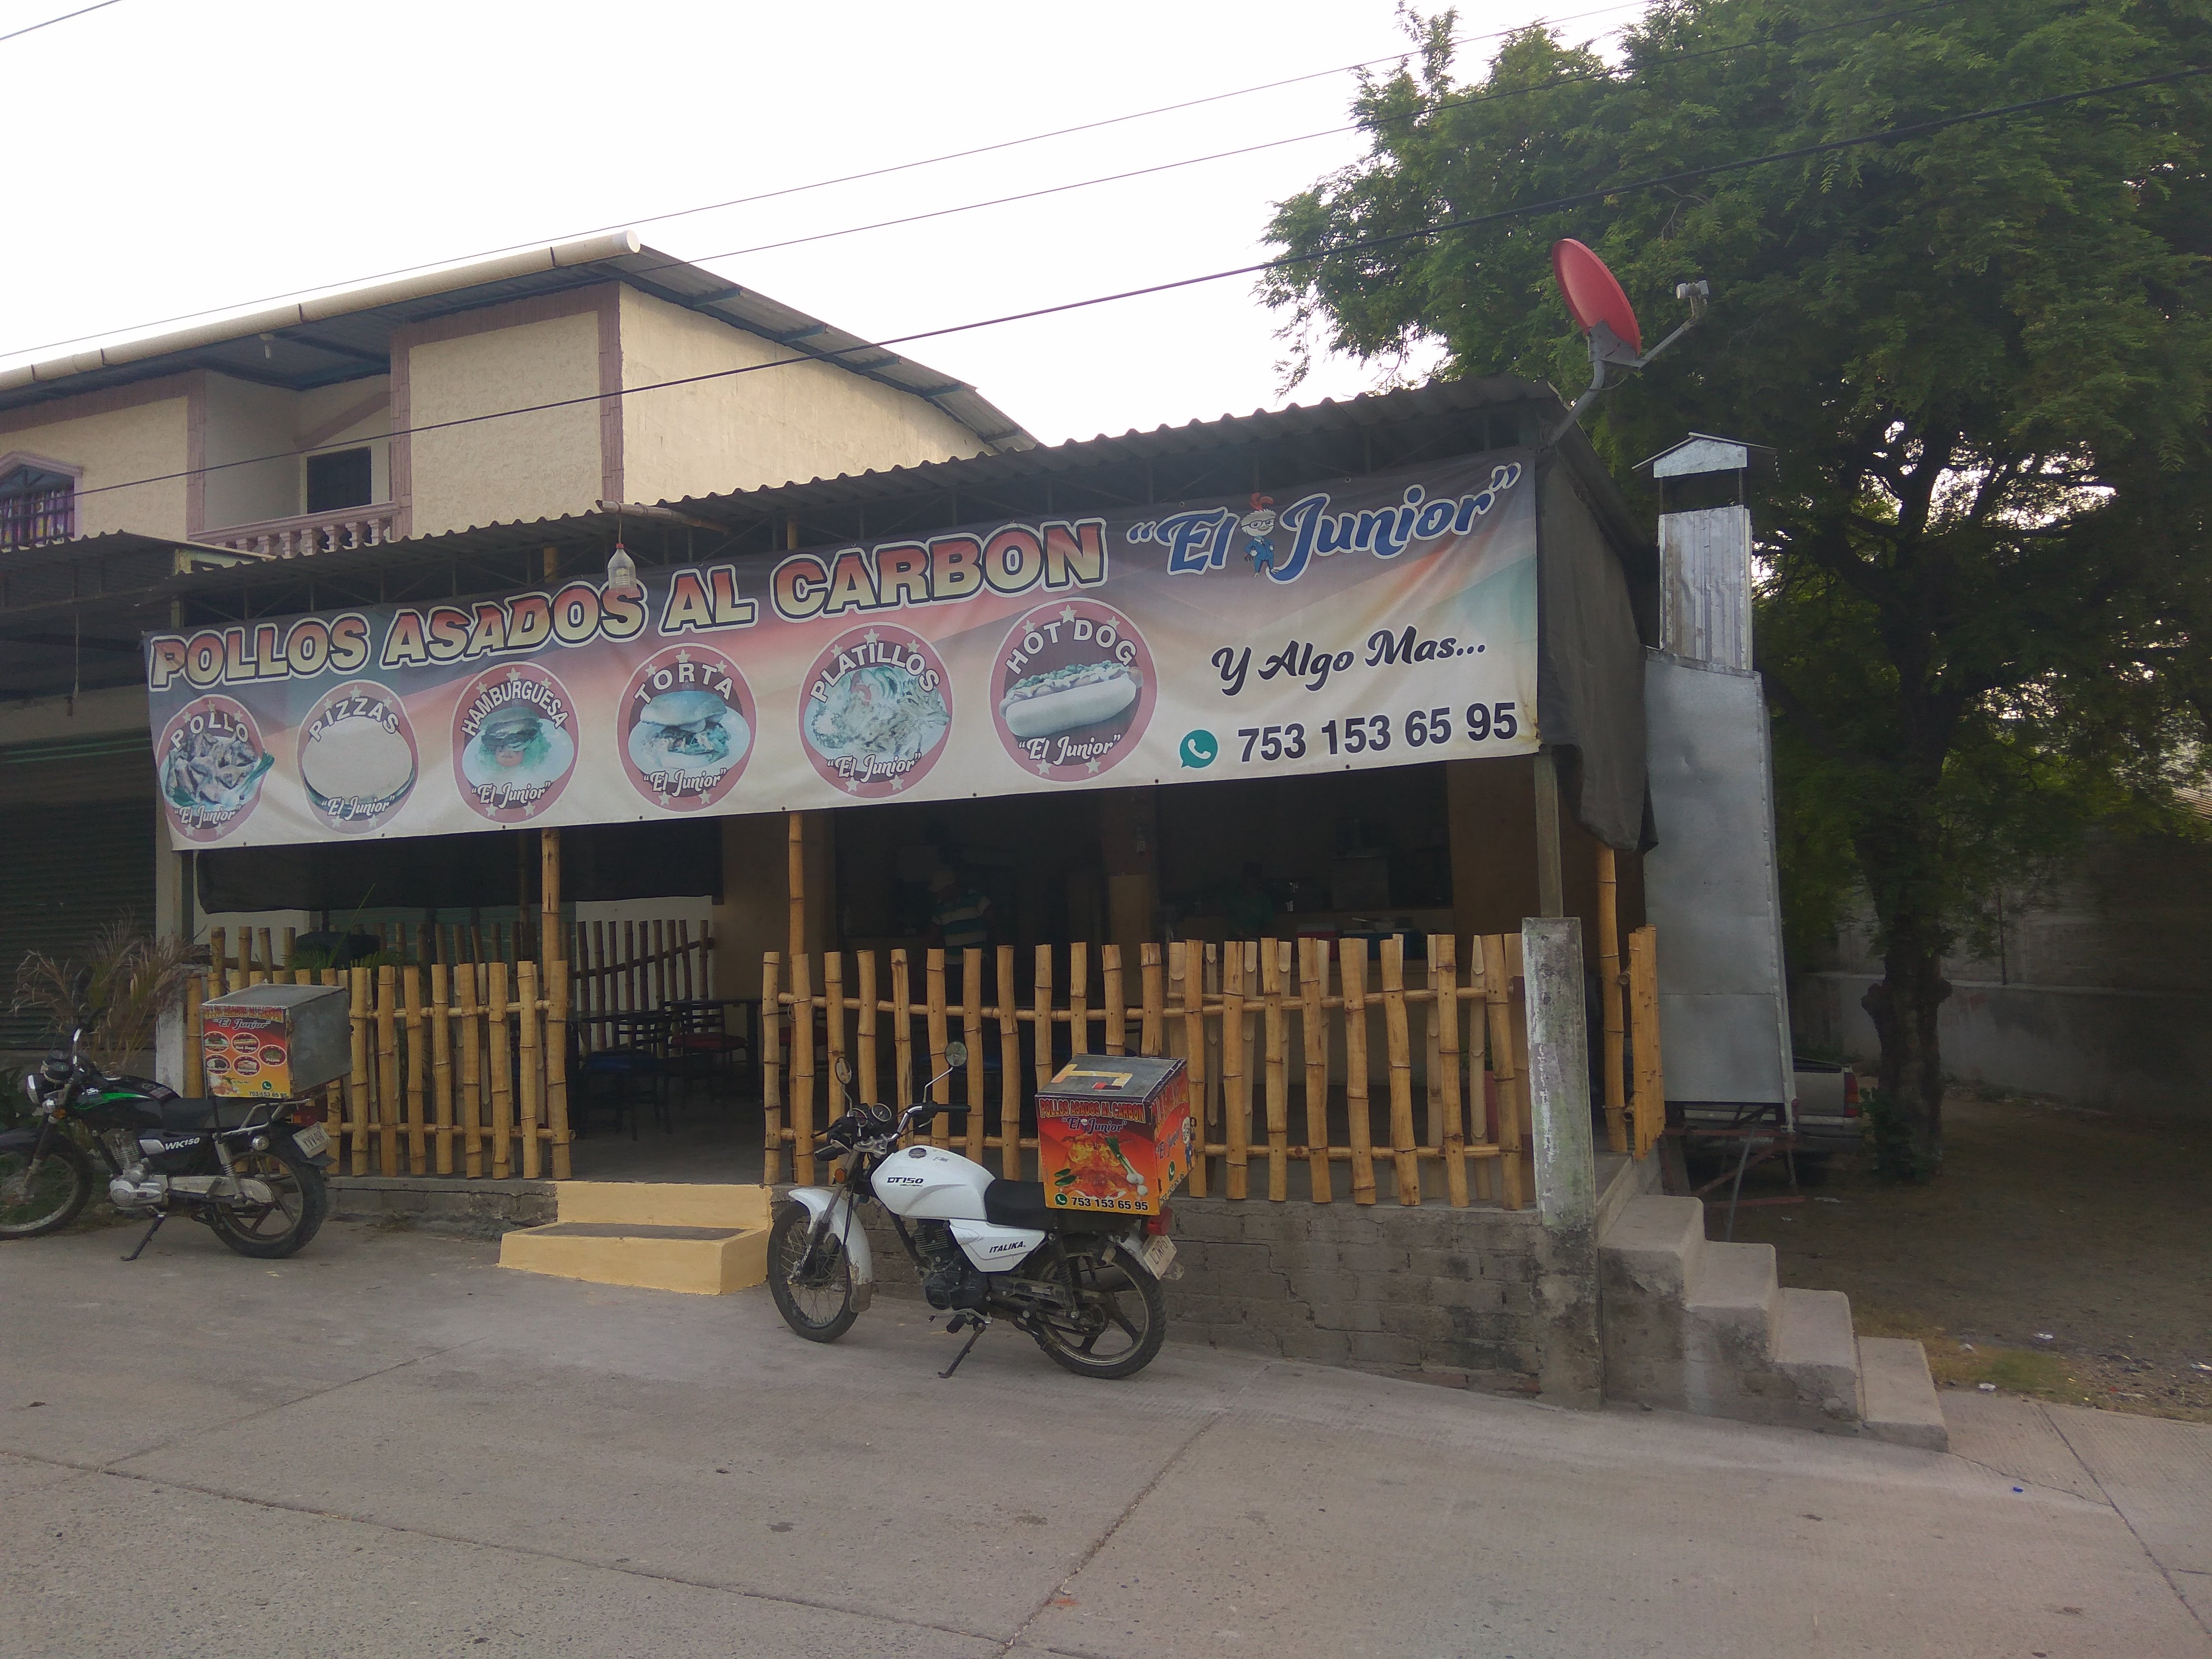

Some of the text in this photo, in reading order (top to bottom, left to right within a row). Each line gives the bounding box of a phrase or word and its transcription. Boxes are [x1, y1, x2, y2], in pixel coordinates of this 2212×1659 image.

[149, 517, 1108, 692] POLLOS ASADOS AL CARBON
[1005, 619, 1137, 675] HOT DOG
[1211, 625, 1486, 696] Y Algo Mas...
[634, 662, 733, 705] TORTA
[809, 641, 940, 703] PLATILLOS
[170, 711, 249, 750] POLLO
[309, 697, 399, 742] PIZZAS
[461, 680, 569, 736] HAMBURGUESA
[1238, 701, 1518, 762] 753 153 65 95
[1039, 1099, 1146, 1123] POLLOS ASADOS AL CARBON
[165, 1137, 200, 1150] WK150
[1071, 1197, 1148, 1210] 753 153 65 95
[989, 1241, 1023, 1253] ITALIKA
